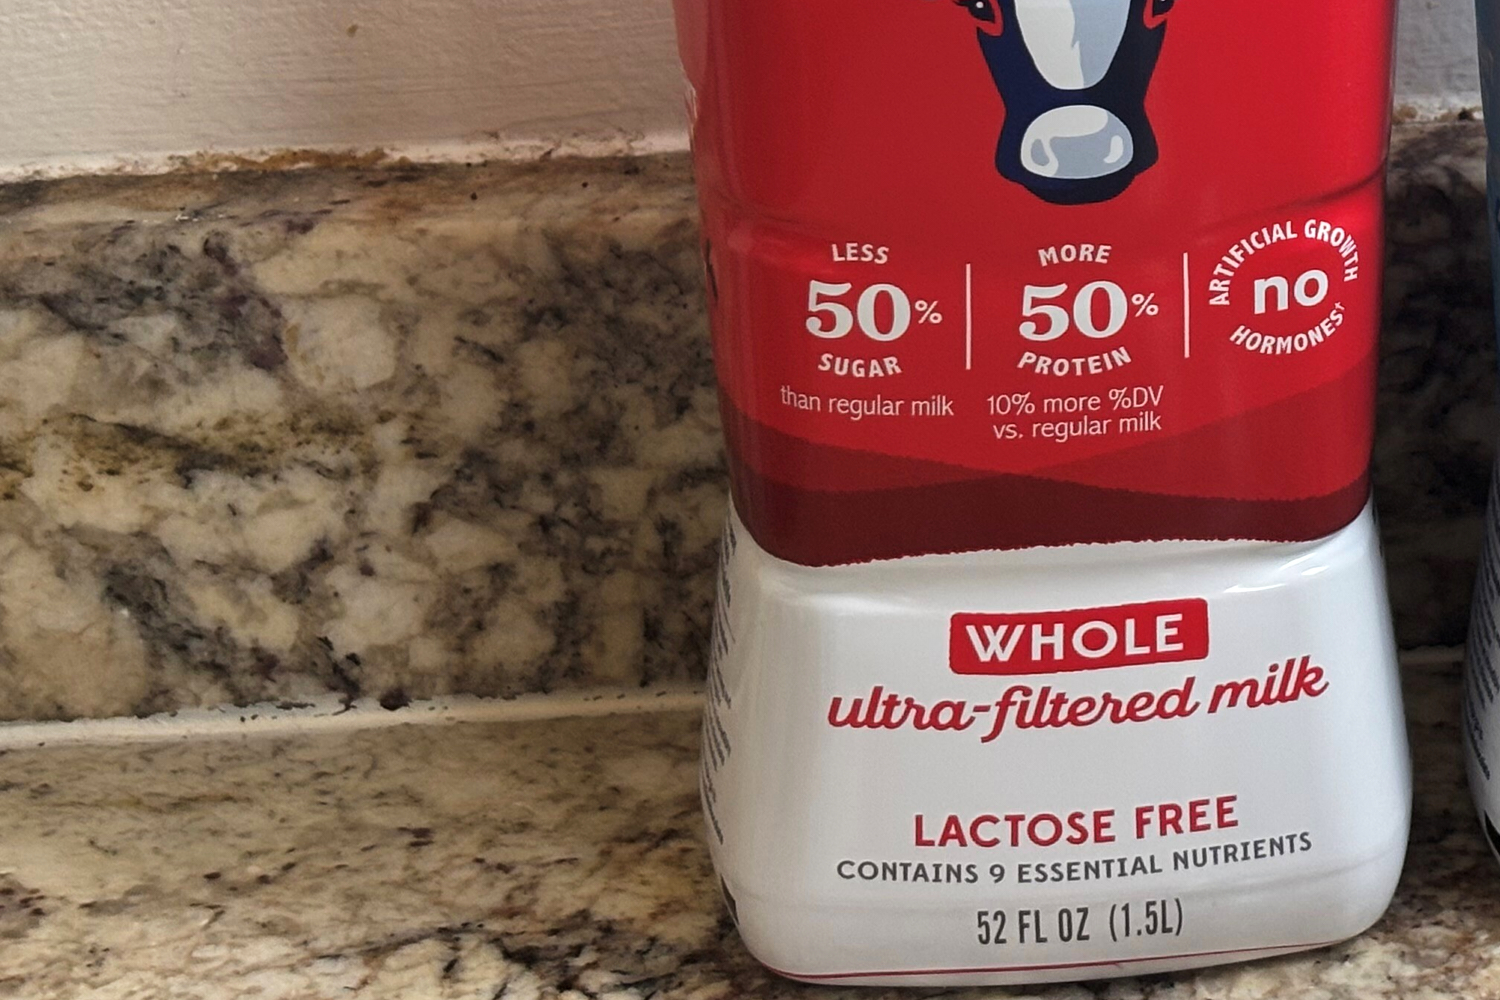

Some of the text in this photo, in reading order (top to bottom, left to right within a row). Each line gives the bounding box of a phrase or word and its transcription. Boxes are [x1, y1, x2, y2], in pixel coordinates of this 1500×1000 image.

[831, 242, 889, 265] LESS
[1038, 243, 1112, 267] MORE
[1209, 219, 1359, 305] ARTIFICIAL GROWTH
[805, 280, 943, 342] 50%
[1018, 280, 1159, 342] 50%
[1254, 269, 1329, 314] no
[818, 352, 902, 378] SUGAR
[1018, 345, 1132, 377] PROTEIN
[780, 385, 954, 421] than regular milk
[986, 385, 1164, 416] 10% more %DV
[993, 411, 1162, 444] vs. regular milk
[965, 612, 1184, 663] WHOLE
[827, 654, 1330, 743] ultra-filtered milk
[914, 794, 1239, 848] LACTOSE FREE
[836, 831, 1312, 884] CONTAINS 9 ESSENTIAL NUTRIENTS
[976, 898, 1184, 945] 52 FL OZ (1.5L)
